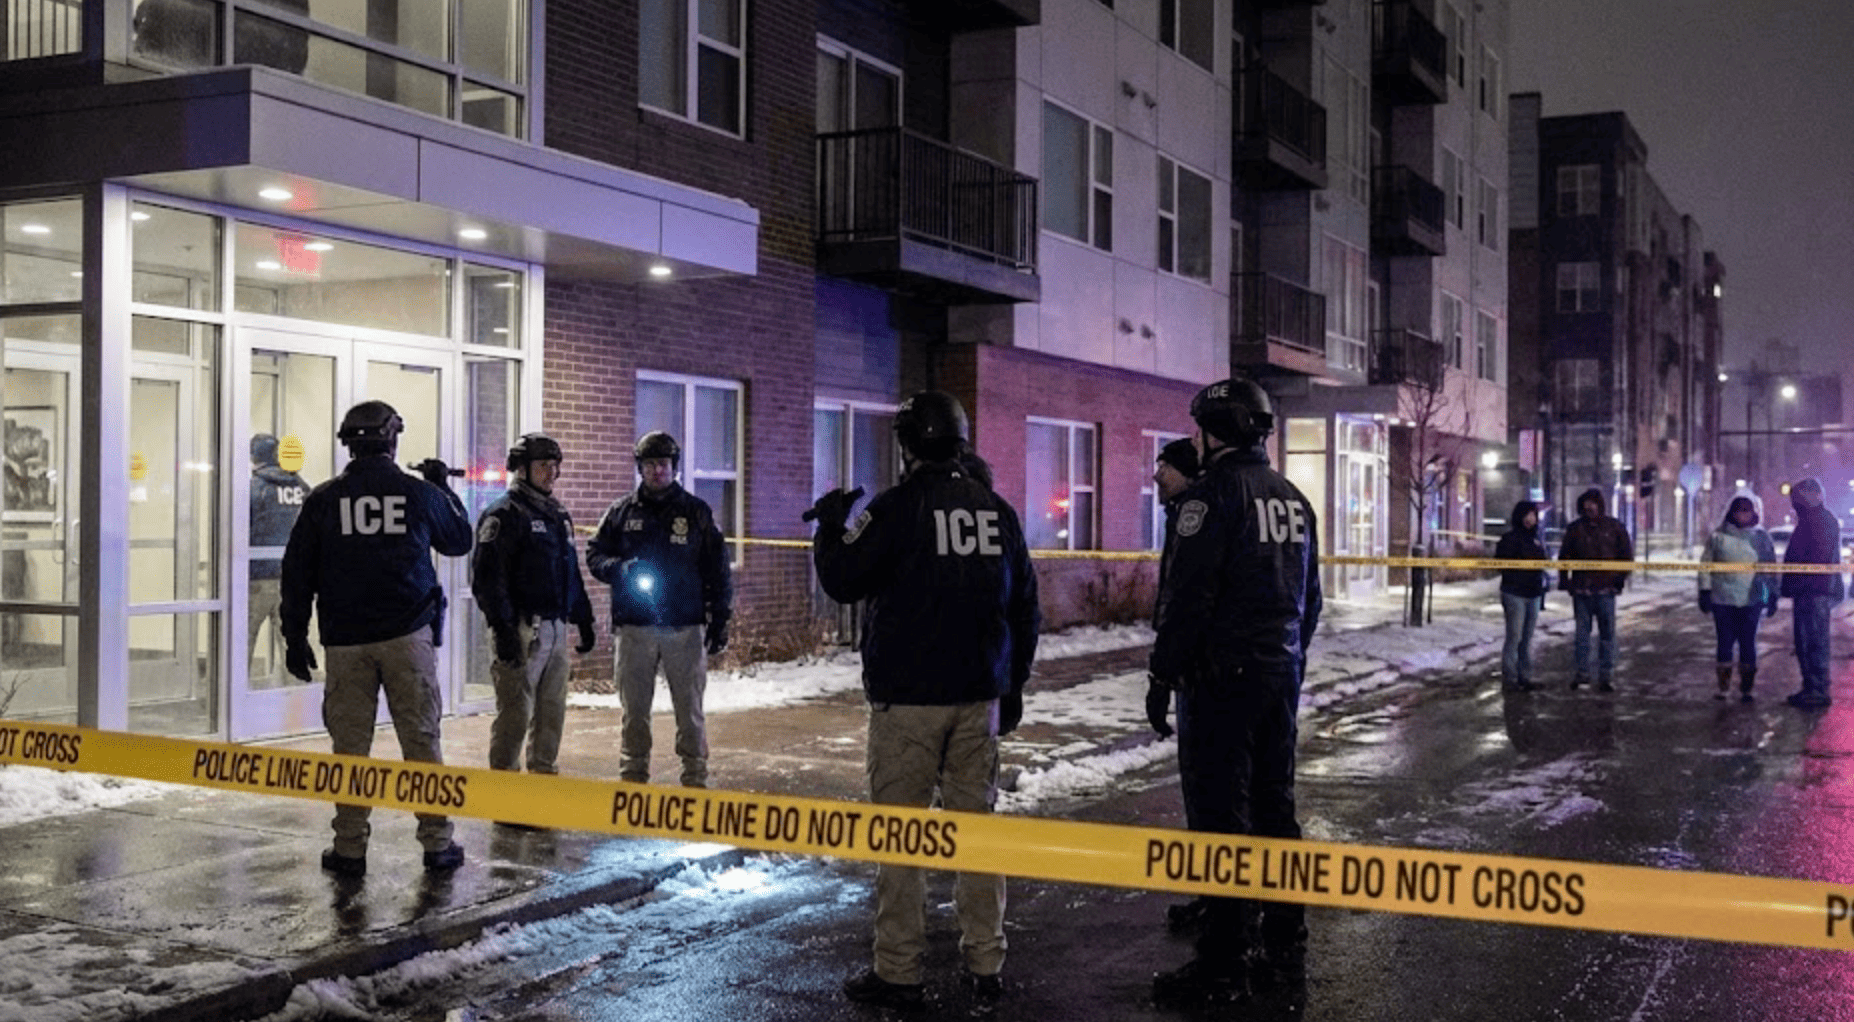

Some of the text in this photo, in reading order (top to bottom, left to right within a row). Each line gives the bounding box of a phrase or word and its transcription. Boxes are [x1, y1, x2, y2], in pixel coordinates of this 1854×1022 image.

[340, 496, 406, 535] ICE
[933, 508, 1003, 556] ICE
[1254, 497, 1306, 544] ICE
[22, 729, 83, 765] CROSS
[193, 748, 467, 808] POLICE LINE DO NOT CROSS
[612, 790, 958, 859] POLICE LINE DO NOT CROSS
[1146, 838, 1585, 917] POLICE LINE DO NOT CROSS
[1826, 893, 1854, 938] P
